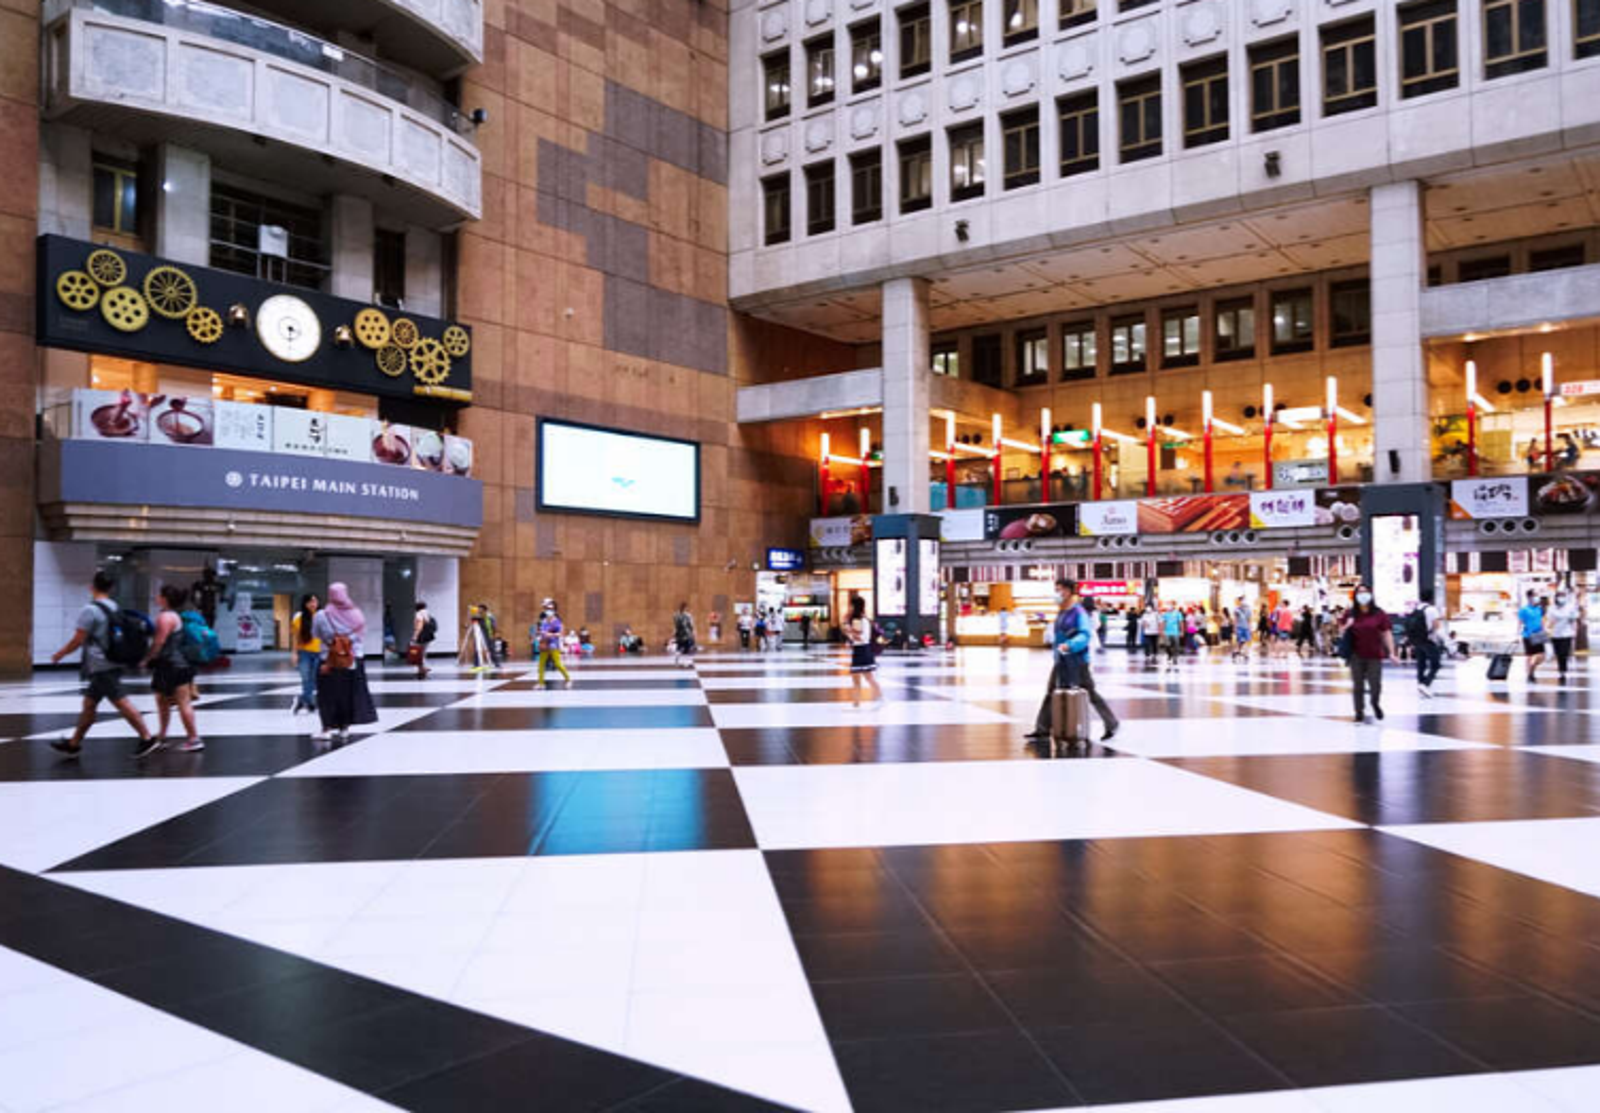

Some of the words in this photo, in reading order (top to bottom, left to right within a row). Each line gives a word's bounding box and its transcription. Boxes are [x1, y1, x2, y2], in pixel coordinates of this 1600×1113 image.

[249, 473, 307, 490] TAIPEI
[312, 479, 356, 494] MAIN
[360, 484, 419, 500] STATION
